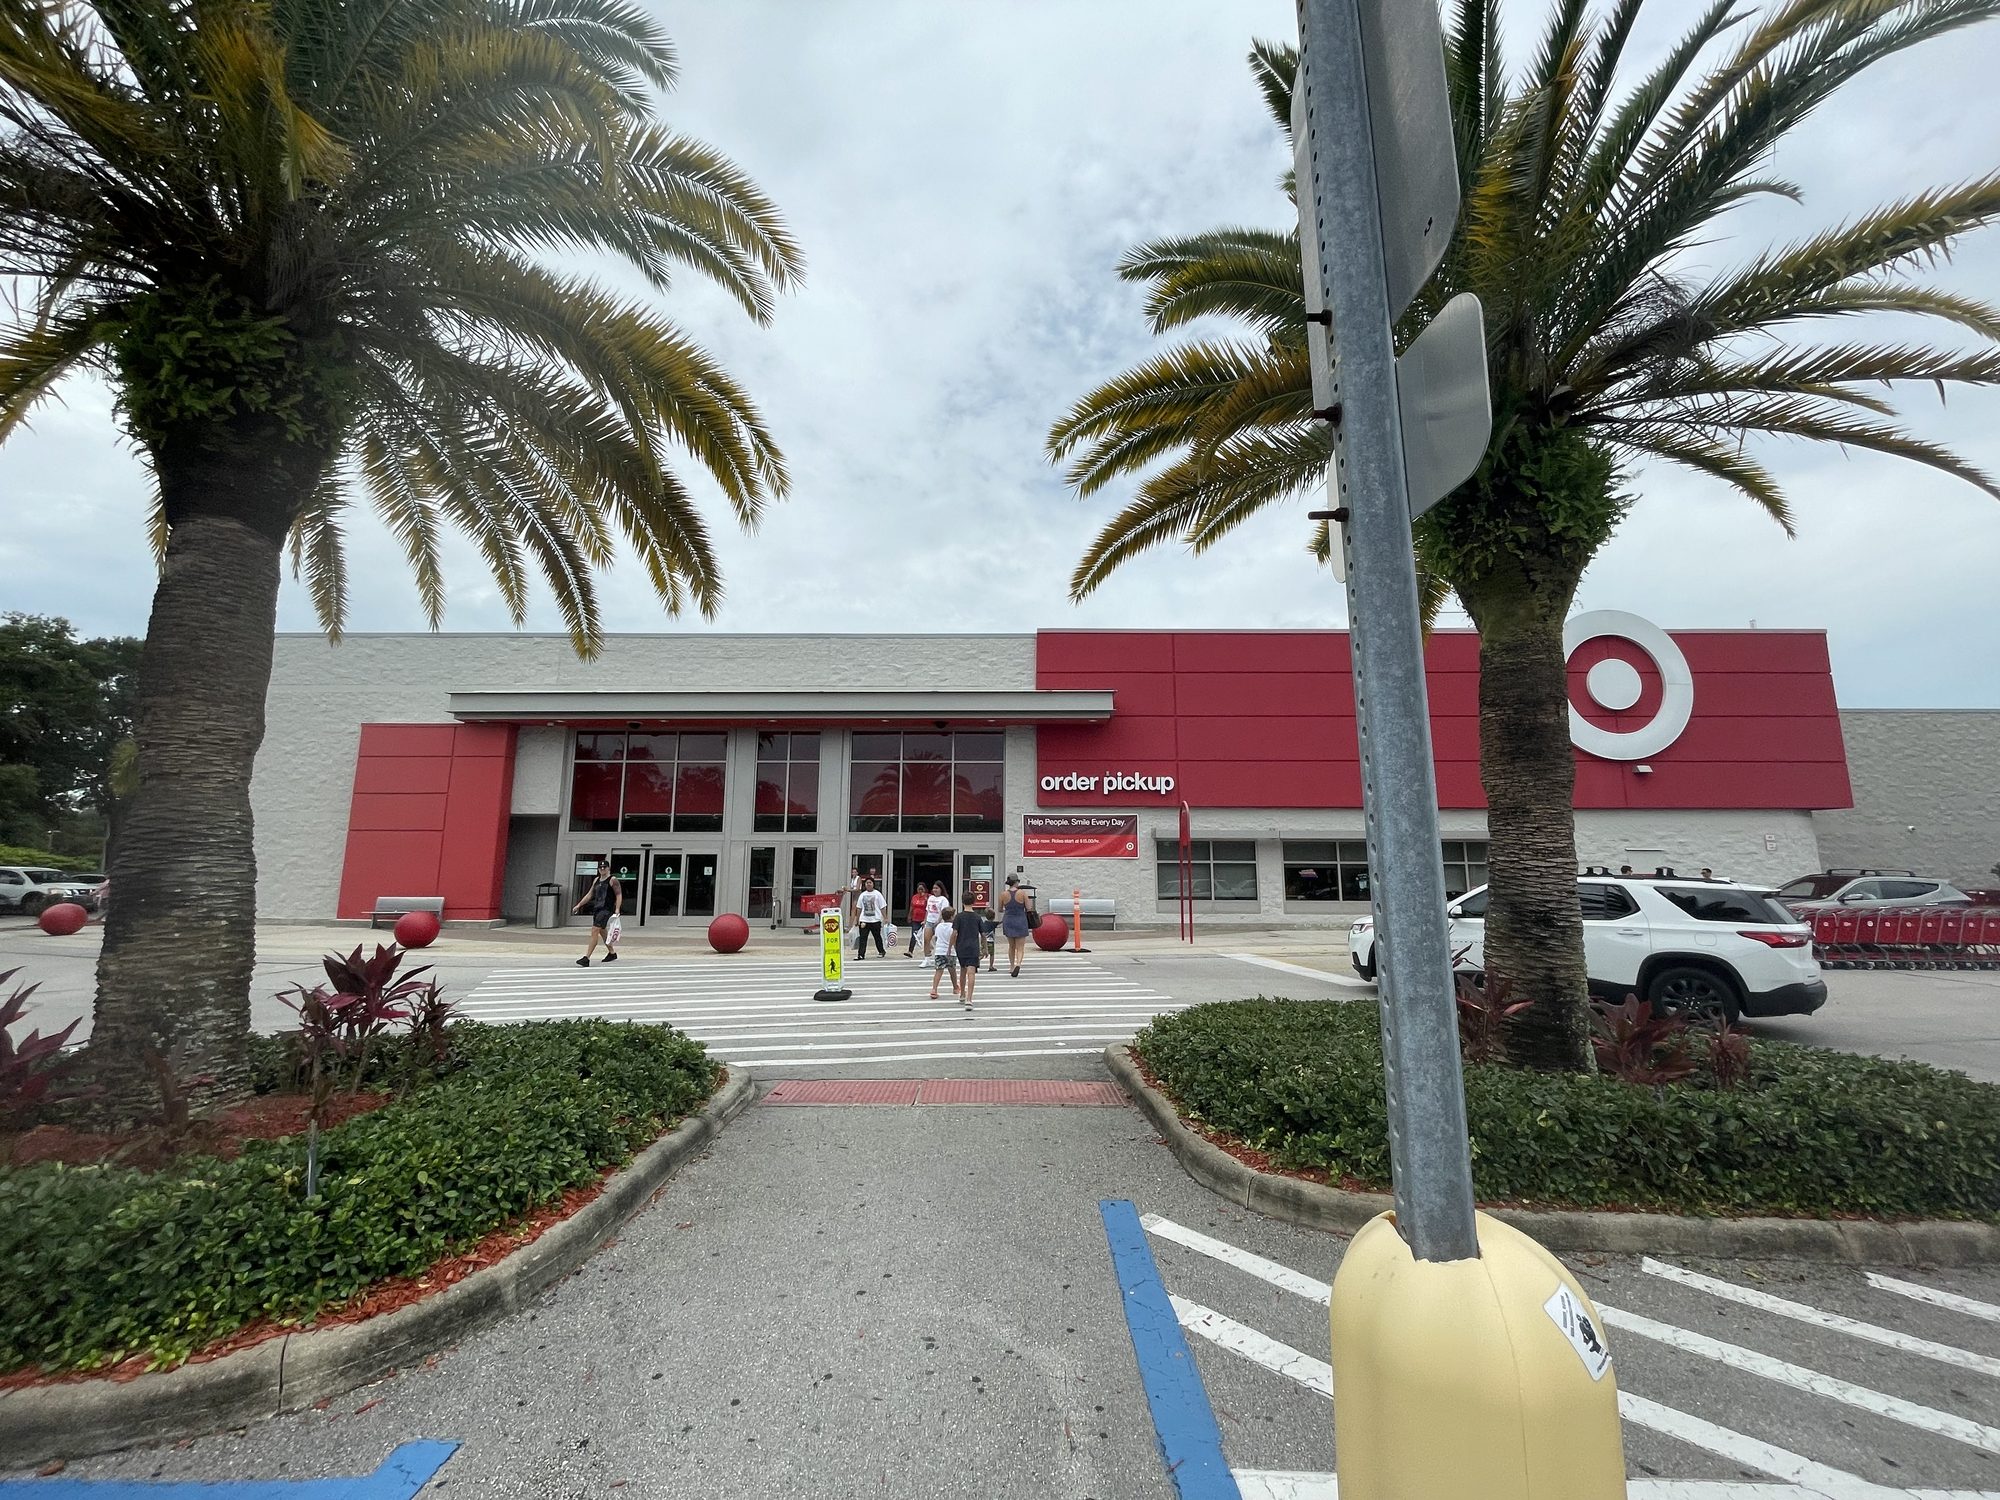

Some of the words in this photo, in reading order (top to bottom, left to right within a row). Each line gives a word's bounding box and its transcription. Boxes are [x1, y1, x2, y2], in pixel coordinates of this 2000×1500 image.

[1041, 772, 1099, 791] order
[1103, 772, 1175, 795] pickup
[1027, 818, 1044, 827] Help
[1045, 818, 1070, 827] People.
[1071, 818, 1090, 826] Smile
[1091, 818, 1110, 827] Every
[1111, 818, 1127, 827] Day.
[825, 922, 839, 930] STOP
